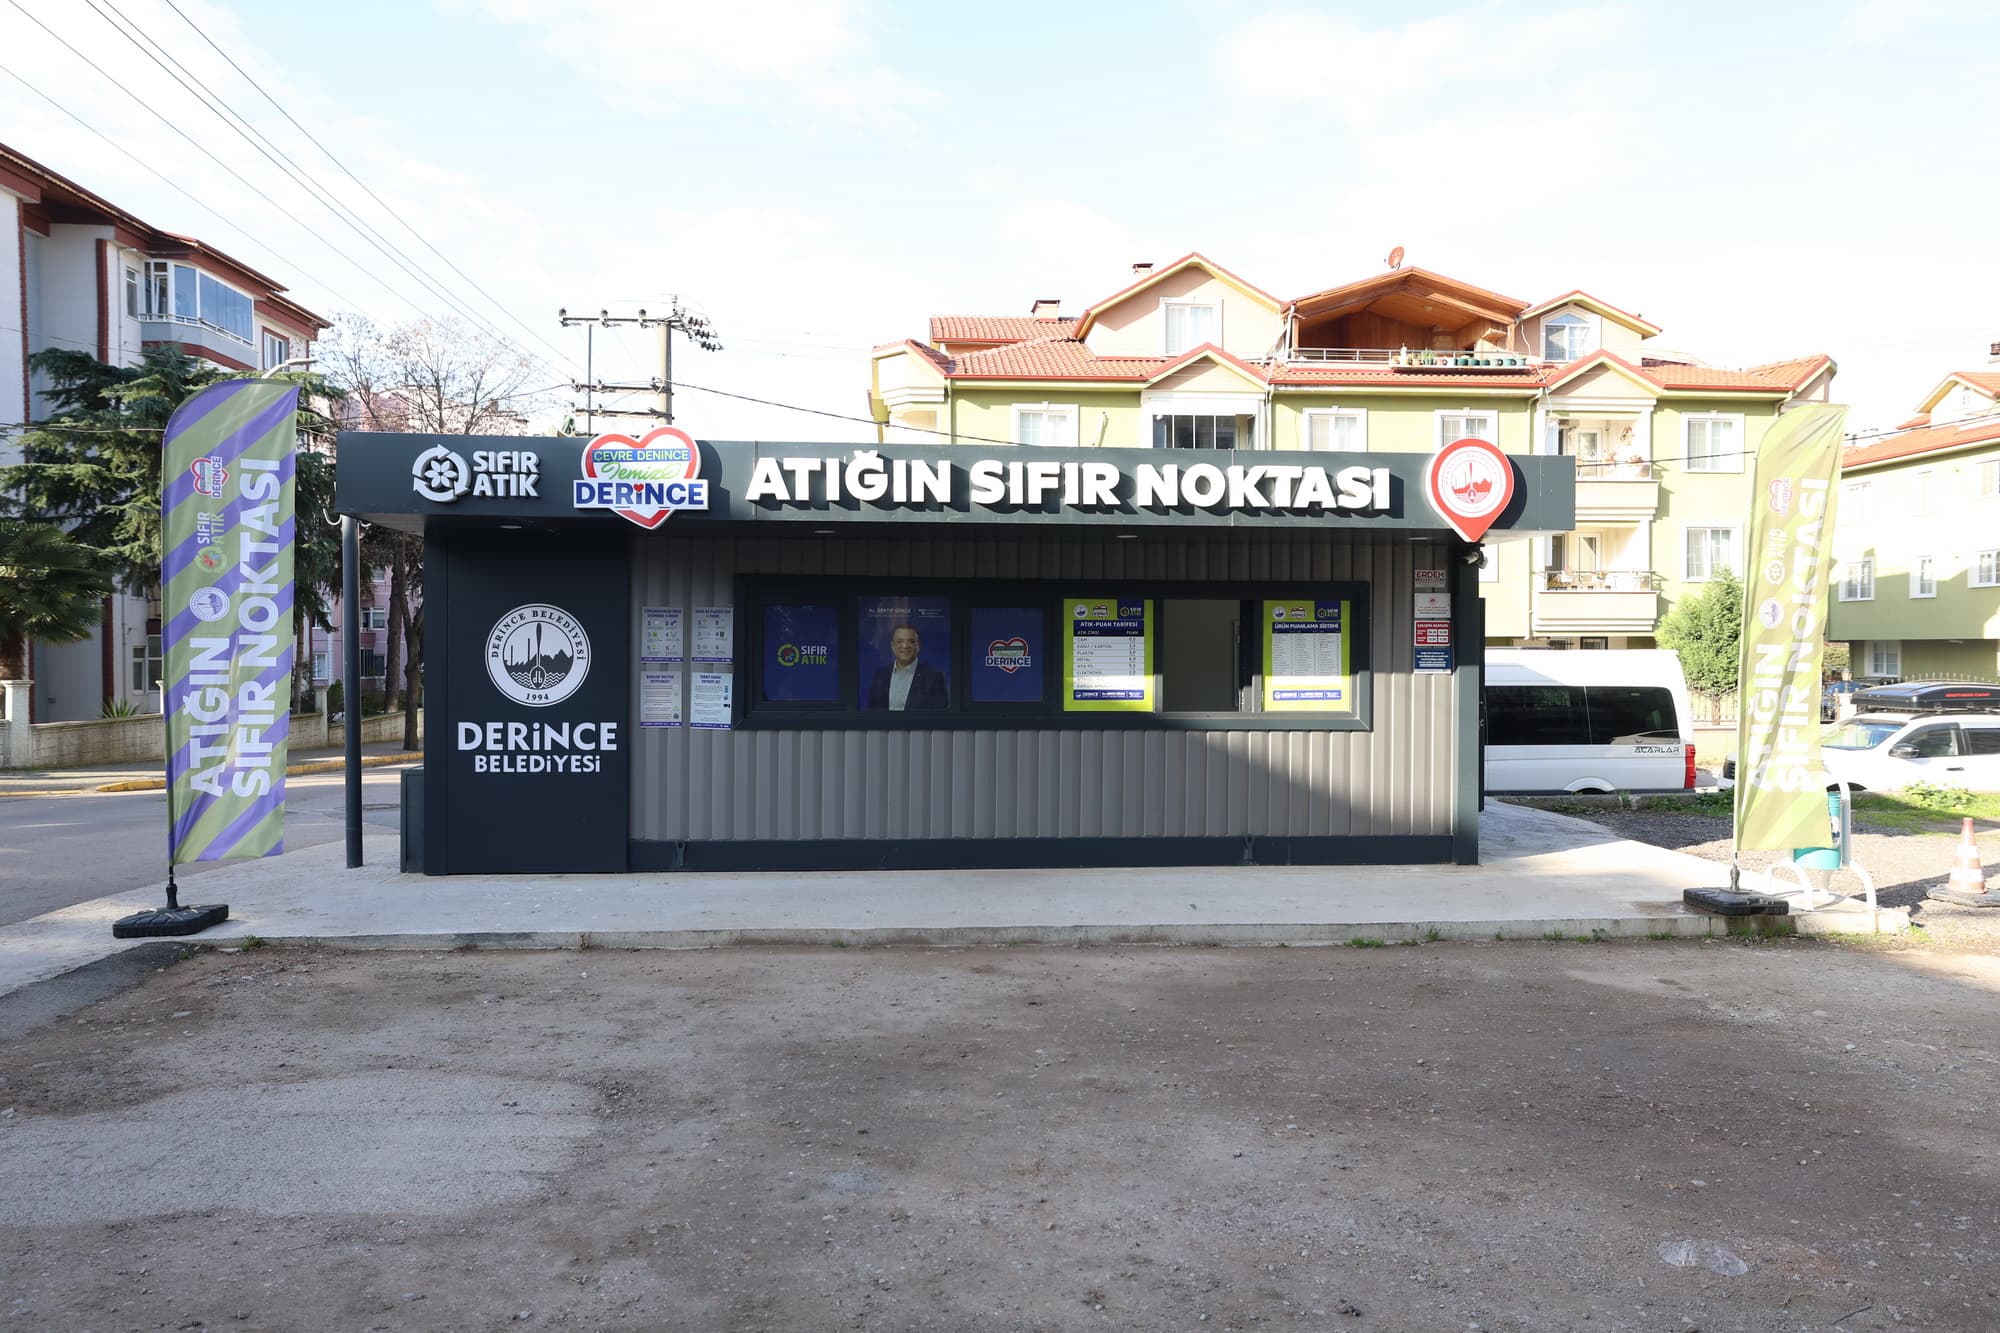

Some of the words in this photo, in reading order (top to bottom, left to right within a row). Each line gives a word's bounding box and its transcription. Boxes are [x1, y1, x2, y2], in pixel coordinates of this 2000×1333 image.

[473, 451, 539, 473] SIFIR
[745, 450, 951, 504] ATIĞIN
[970, 459, 1121, 505] SIFIR
[1137, 463, 1390, 510] NOKTASI
[473, 474, 539, 496] ATIK
[197, 511, 210, 545] SIFIR
[211, 512, 225, 545] ATIK
[238, 458, 281, 667] NOKTASI
[1786, 478, 1829, 673] NOKTASI
[532, 610, 586, 660] BELEDİYESİ
[800, 645, 828, 655] SIFIR
[801, 655, 827, 665] ATIK
[183, 637, 230, 798] ATIĞIN
[526, 693, 550, 701] 1994
[231, 680, 277, 798] SIFIR
[1775, 684, 1812, 793] SIFIR
